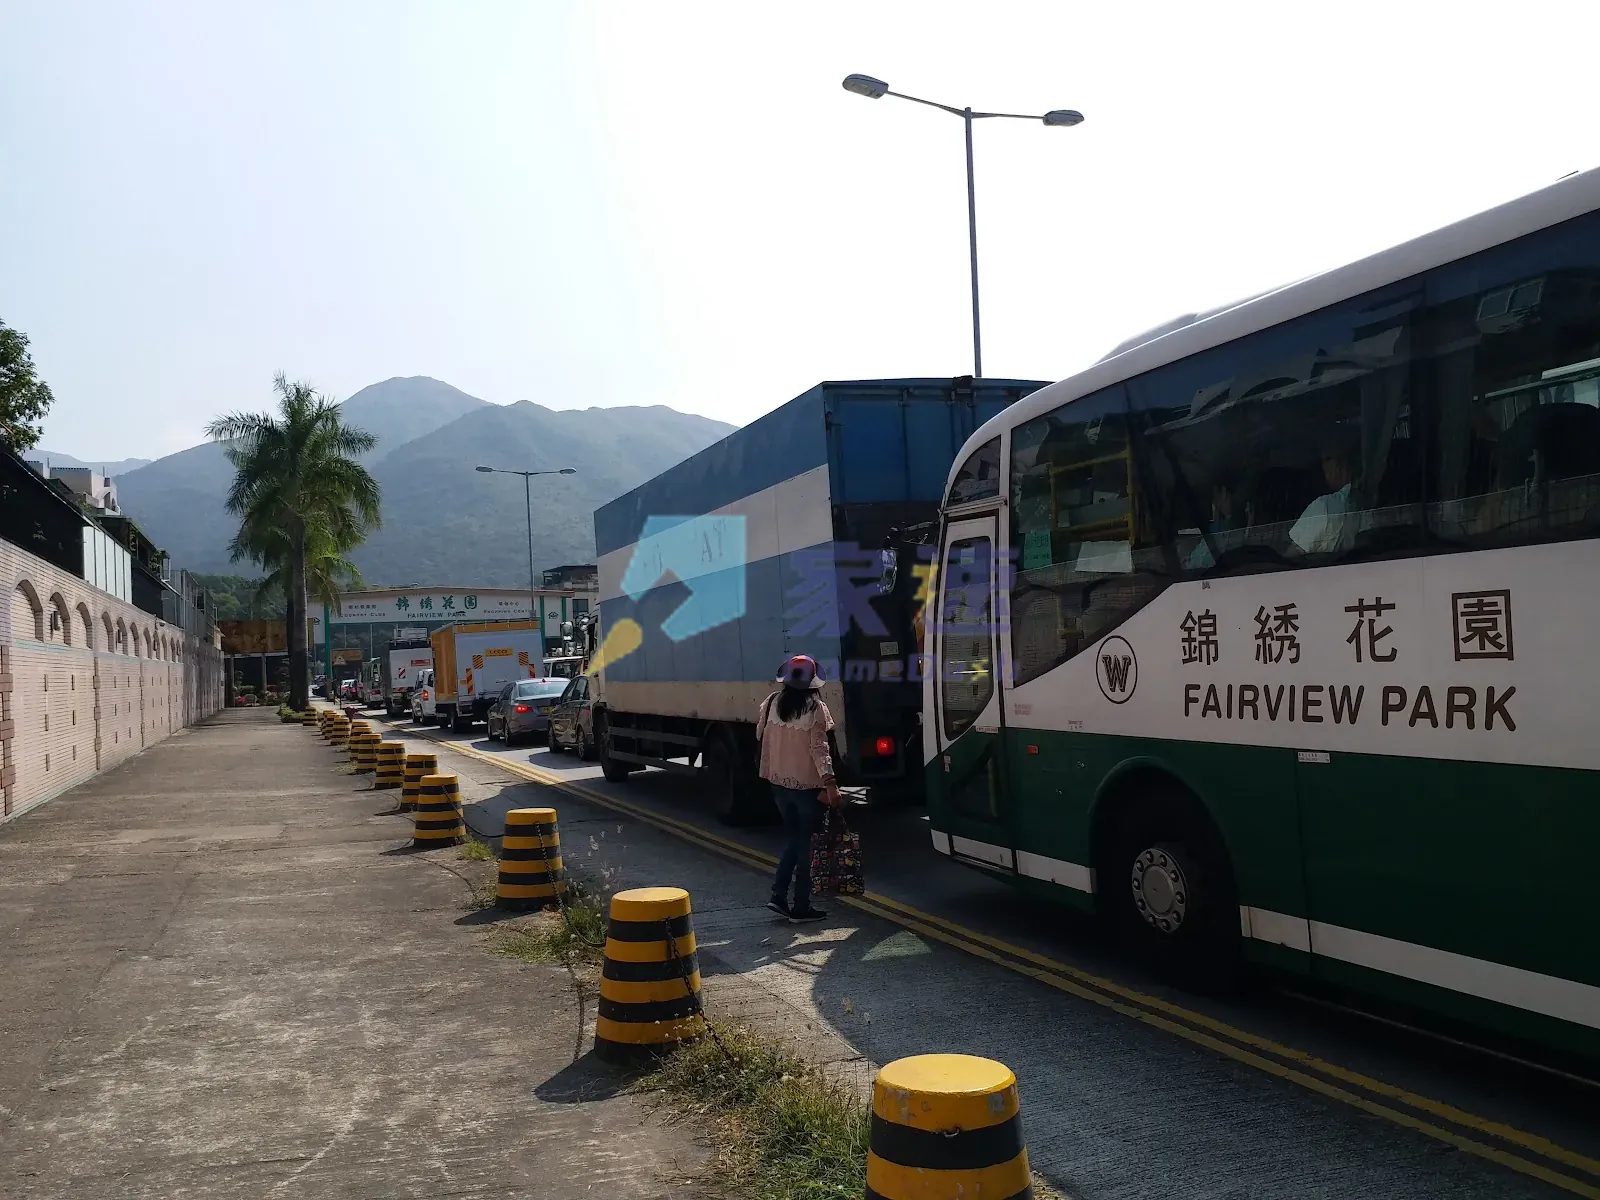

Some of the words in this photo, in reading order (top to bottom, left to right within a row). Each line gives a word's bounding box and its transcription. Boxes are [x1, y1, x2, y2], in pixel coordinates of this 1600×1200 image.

[1180, 589, 1515, 665] 錦綉花園
[1101, 654, 1132, 693] W
[1184, 683, 1365, 725] FAIRVIEW
[1381, 685, 1517, 732] PARK
